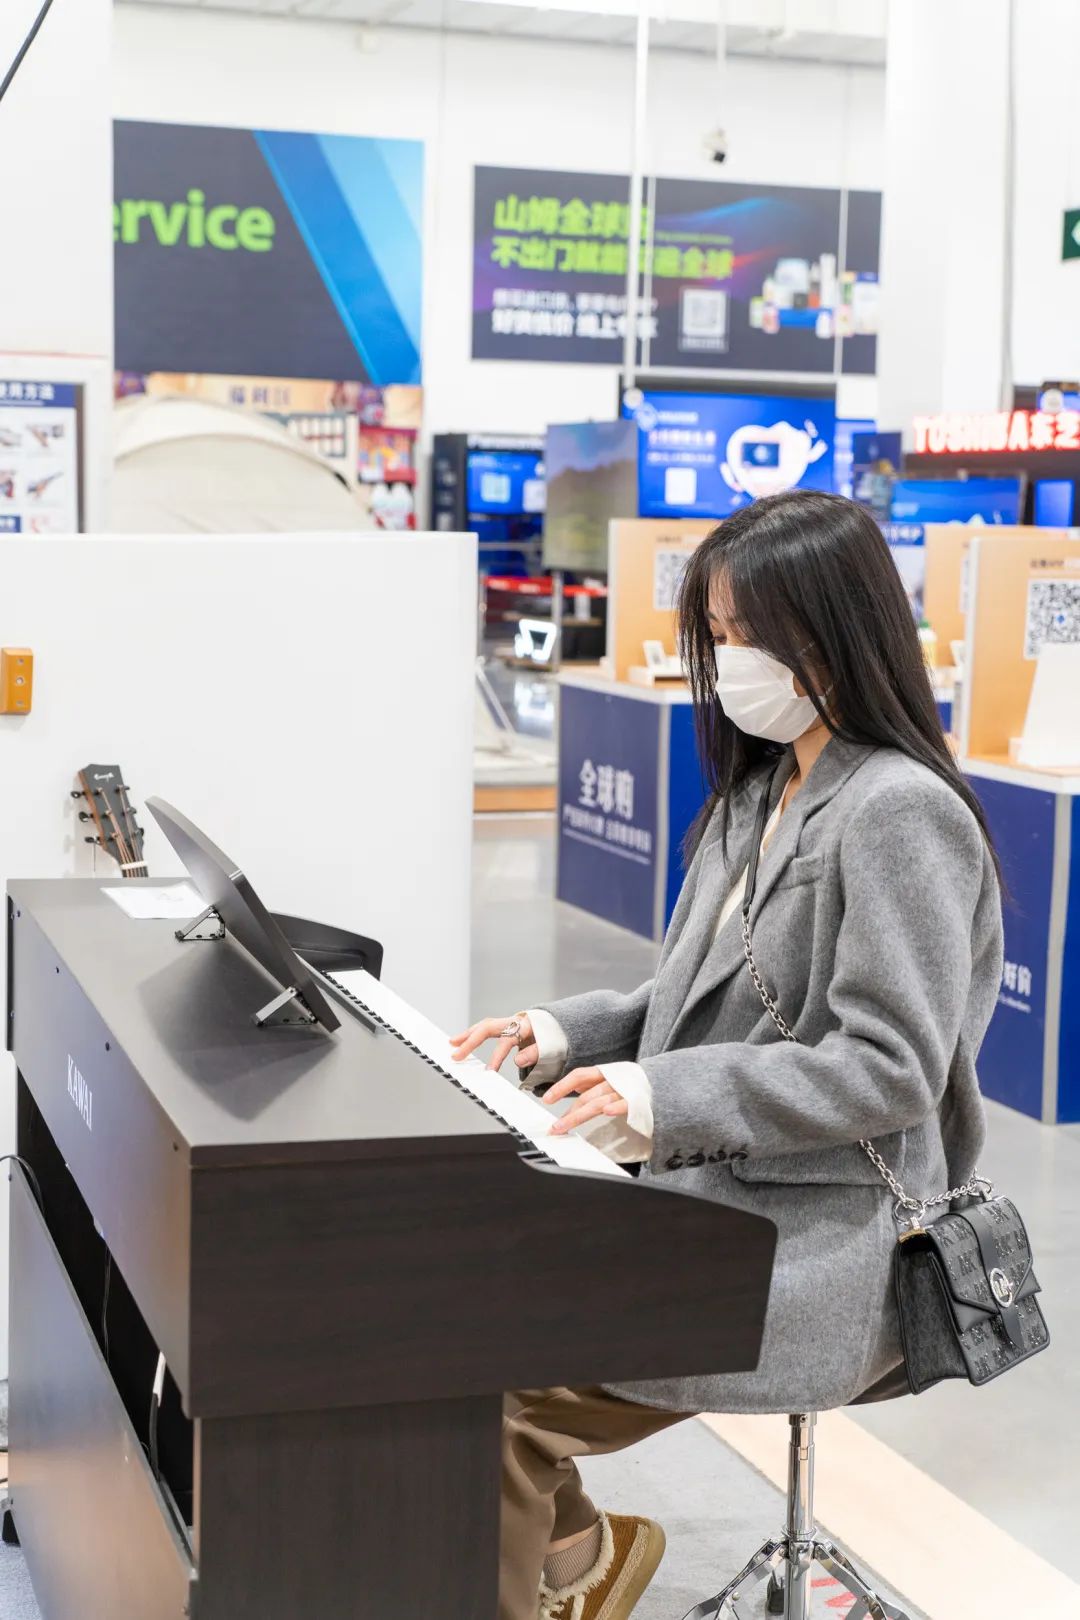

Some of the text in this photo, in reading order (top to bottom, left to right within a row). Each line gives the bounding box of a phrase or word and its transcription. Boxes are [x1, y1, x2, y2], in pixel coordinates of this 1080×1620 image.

[113, 189, 275, 252] rvice
[577, 759, 634, 820] 全球购
[67, 1054, 93, 1132] KAWAI
